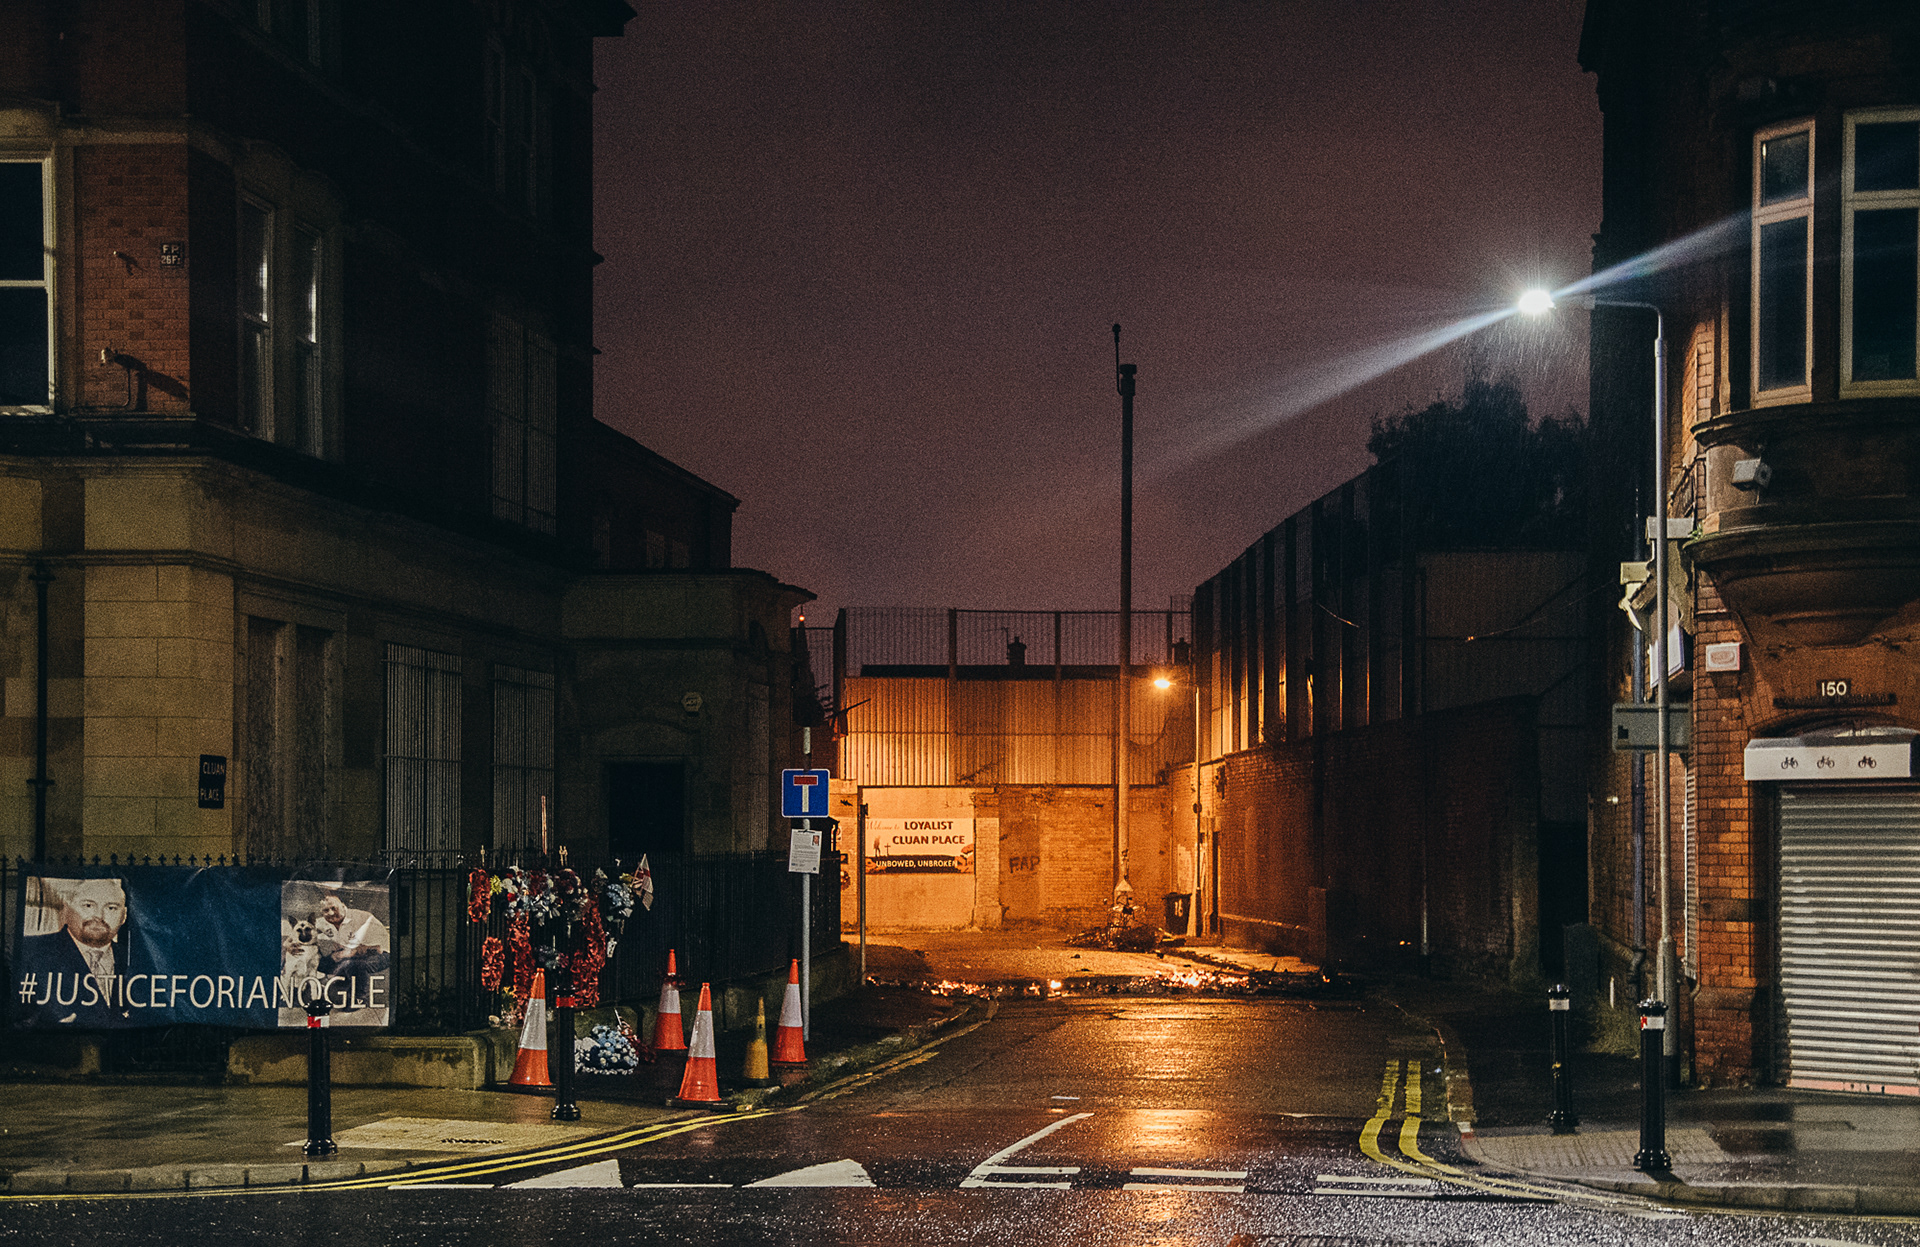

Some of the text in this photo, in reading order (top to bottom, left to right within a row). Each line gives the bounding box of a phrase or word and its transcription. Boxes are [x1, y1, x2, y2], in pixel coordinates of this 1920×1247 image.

[1821, 681, 1847, 697] 150
[202, 761, 226, 775] CLUAN
[903, 820, 954, 831] LOYALIST
[892, 835, 966, 845] CLUAN PLACE
[917, 859, 959, 868] UNBROKEN
[18, 972, 386, 1009] #JUSTICEFORIANOGLE
